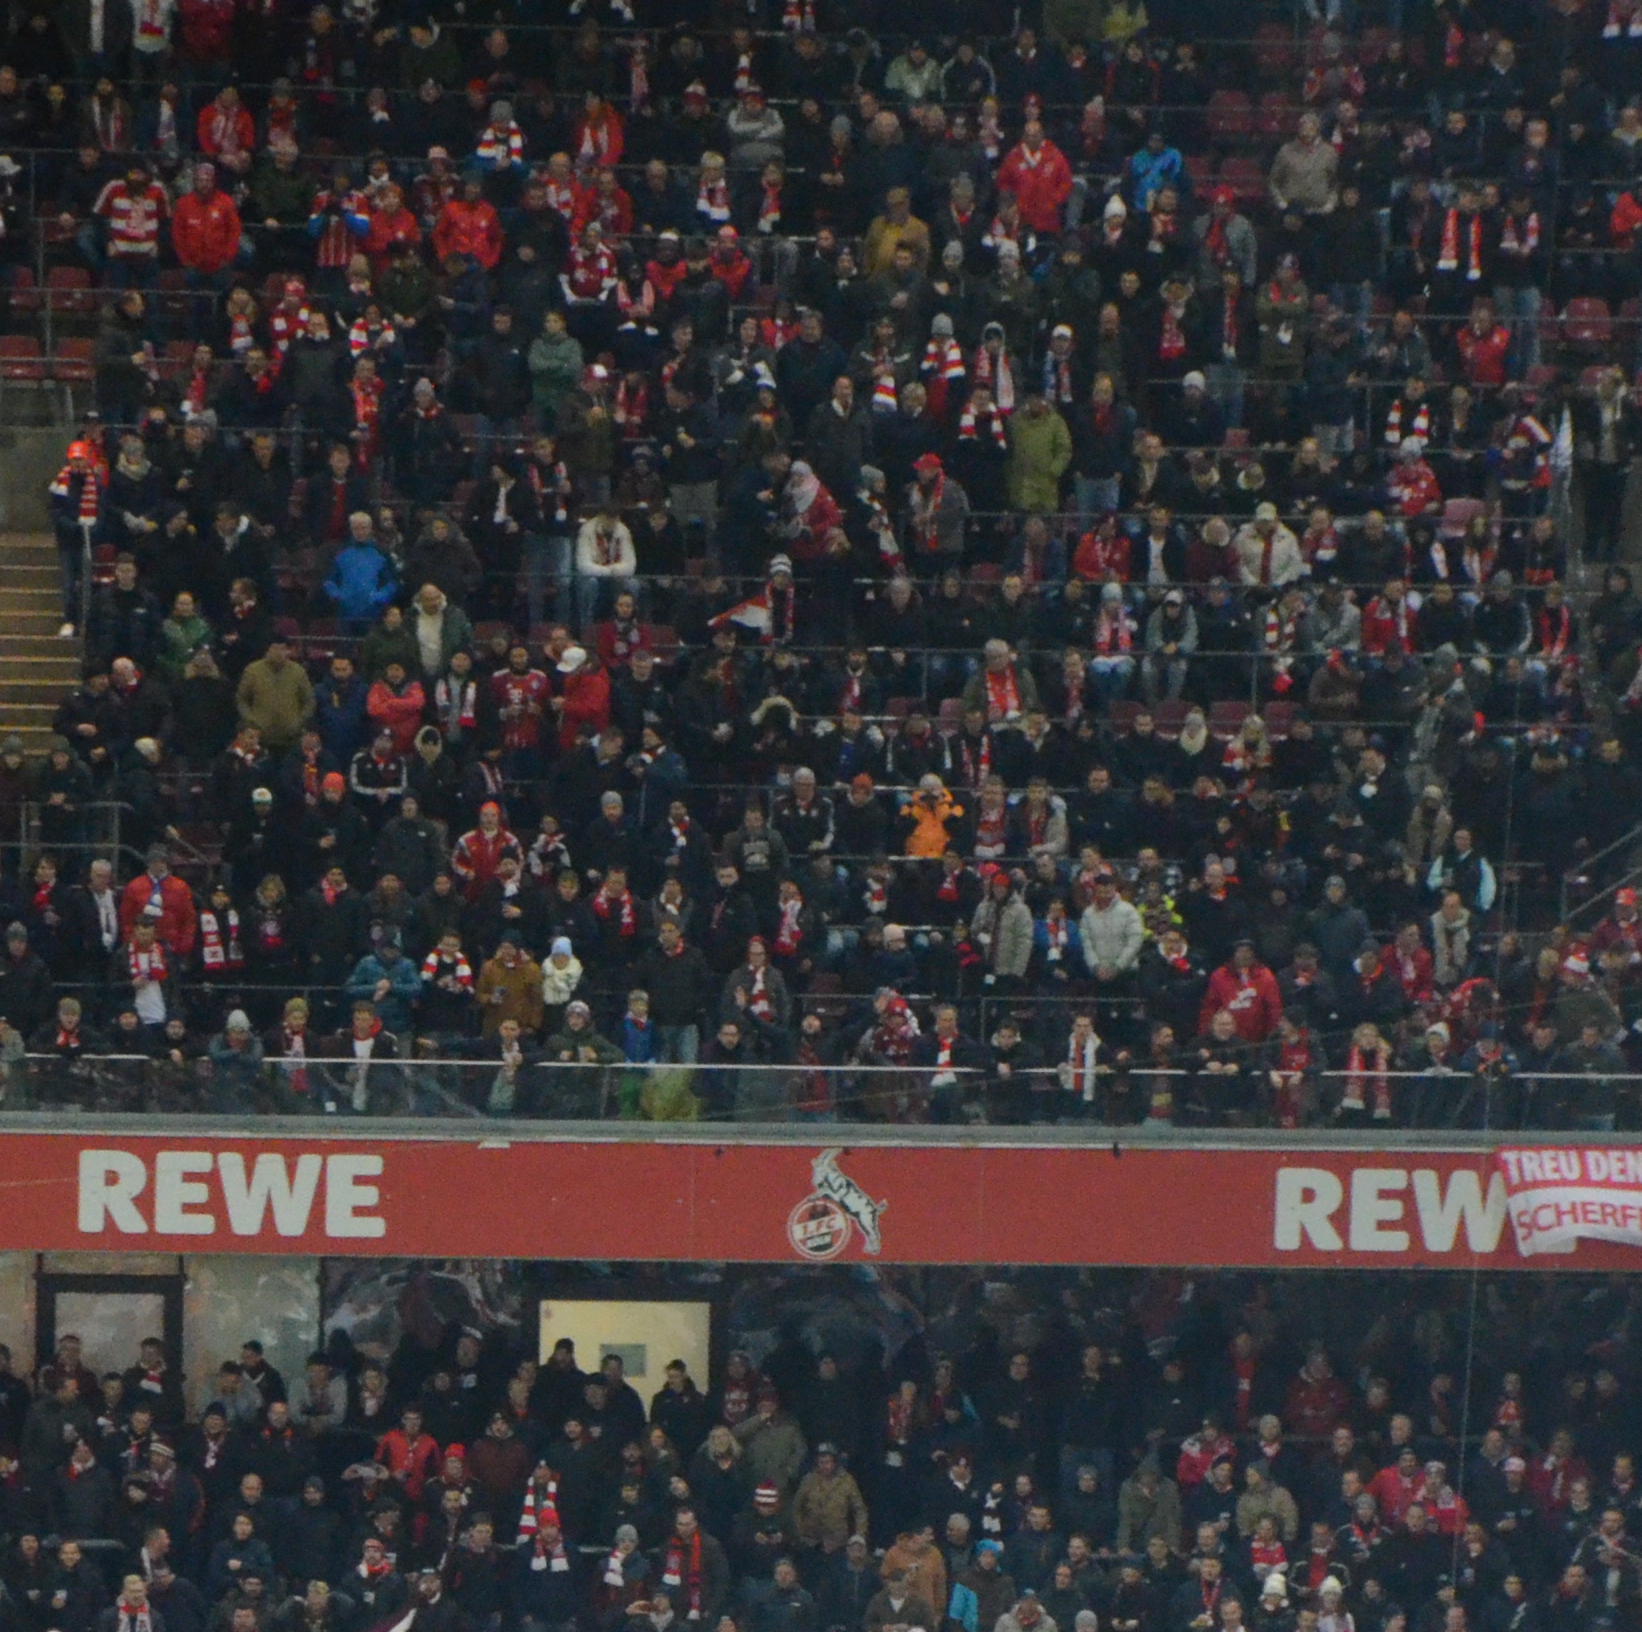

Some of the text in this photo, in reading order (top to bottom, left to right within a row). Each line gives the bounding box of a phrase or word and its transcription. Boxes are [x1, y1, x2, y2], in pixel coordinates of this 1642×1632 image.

[77, 1149, 385, 1237] REWE
[1274, 1166, 1577, 1253] REW
[1501, 1151, 1581, 1184] TREU
